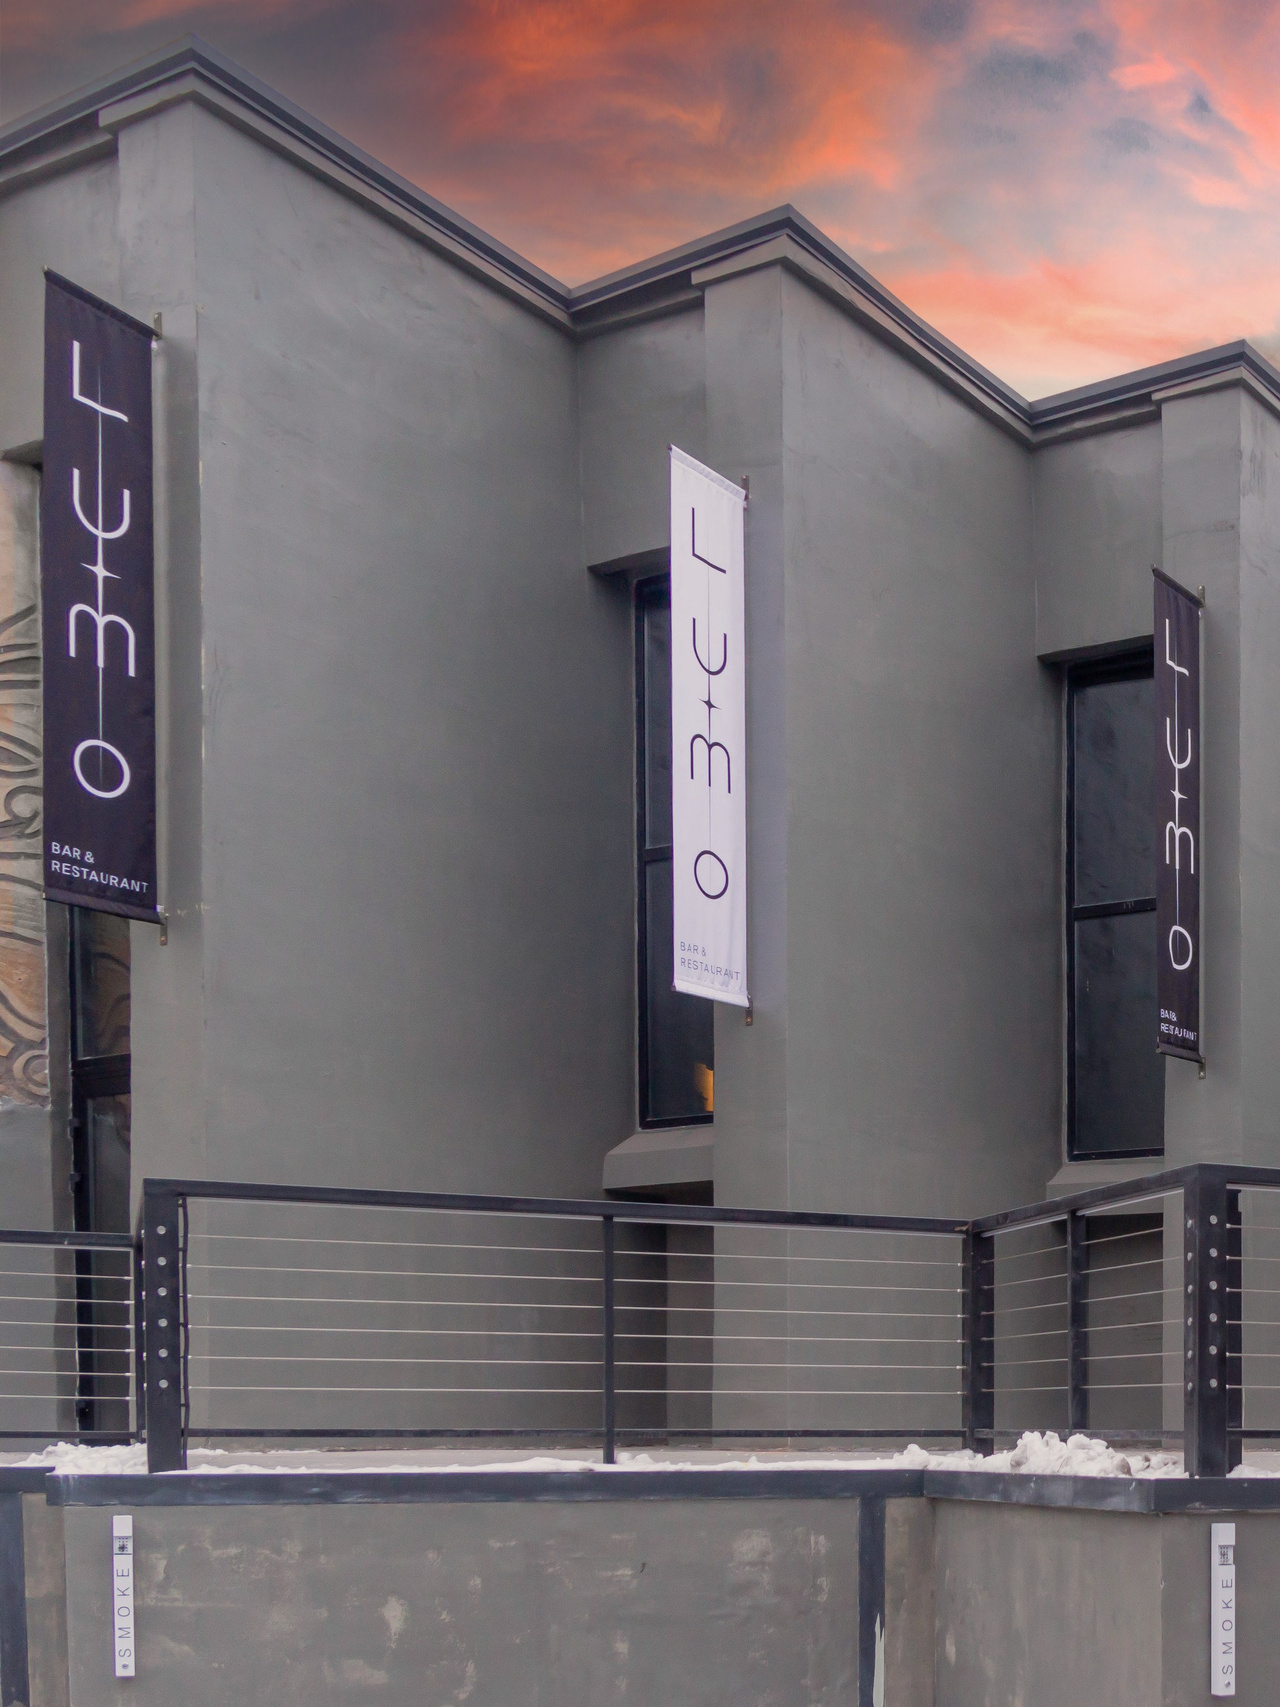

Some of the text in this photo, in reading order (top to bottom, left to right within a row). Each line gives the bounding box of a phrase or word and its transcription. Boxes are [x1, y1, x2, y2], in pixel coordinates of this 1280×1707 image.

[51, 841, 95, 864] BAR &
[51, 860, 149, 893] RESTAURANT
[680, 941, 707, 957] BAR &
[680, 957, 740, 981] RESTAURANT
[116, 1567, 132, 1659] SMOKE
[1221, 1578, 1234, 1675] SMOKE
